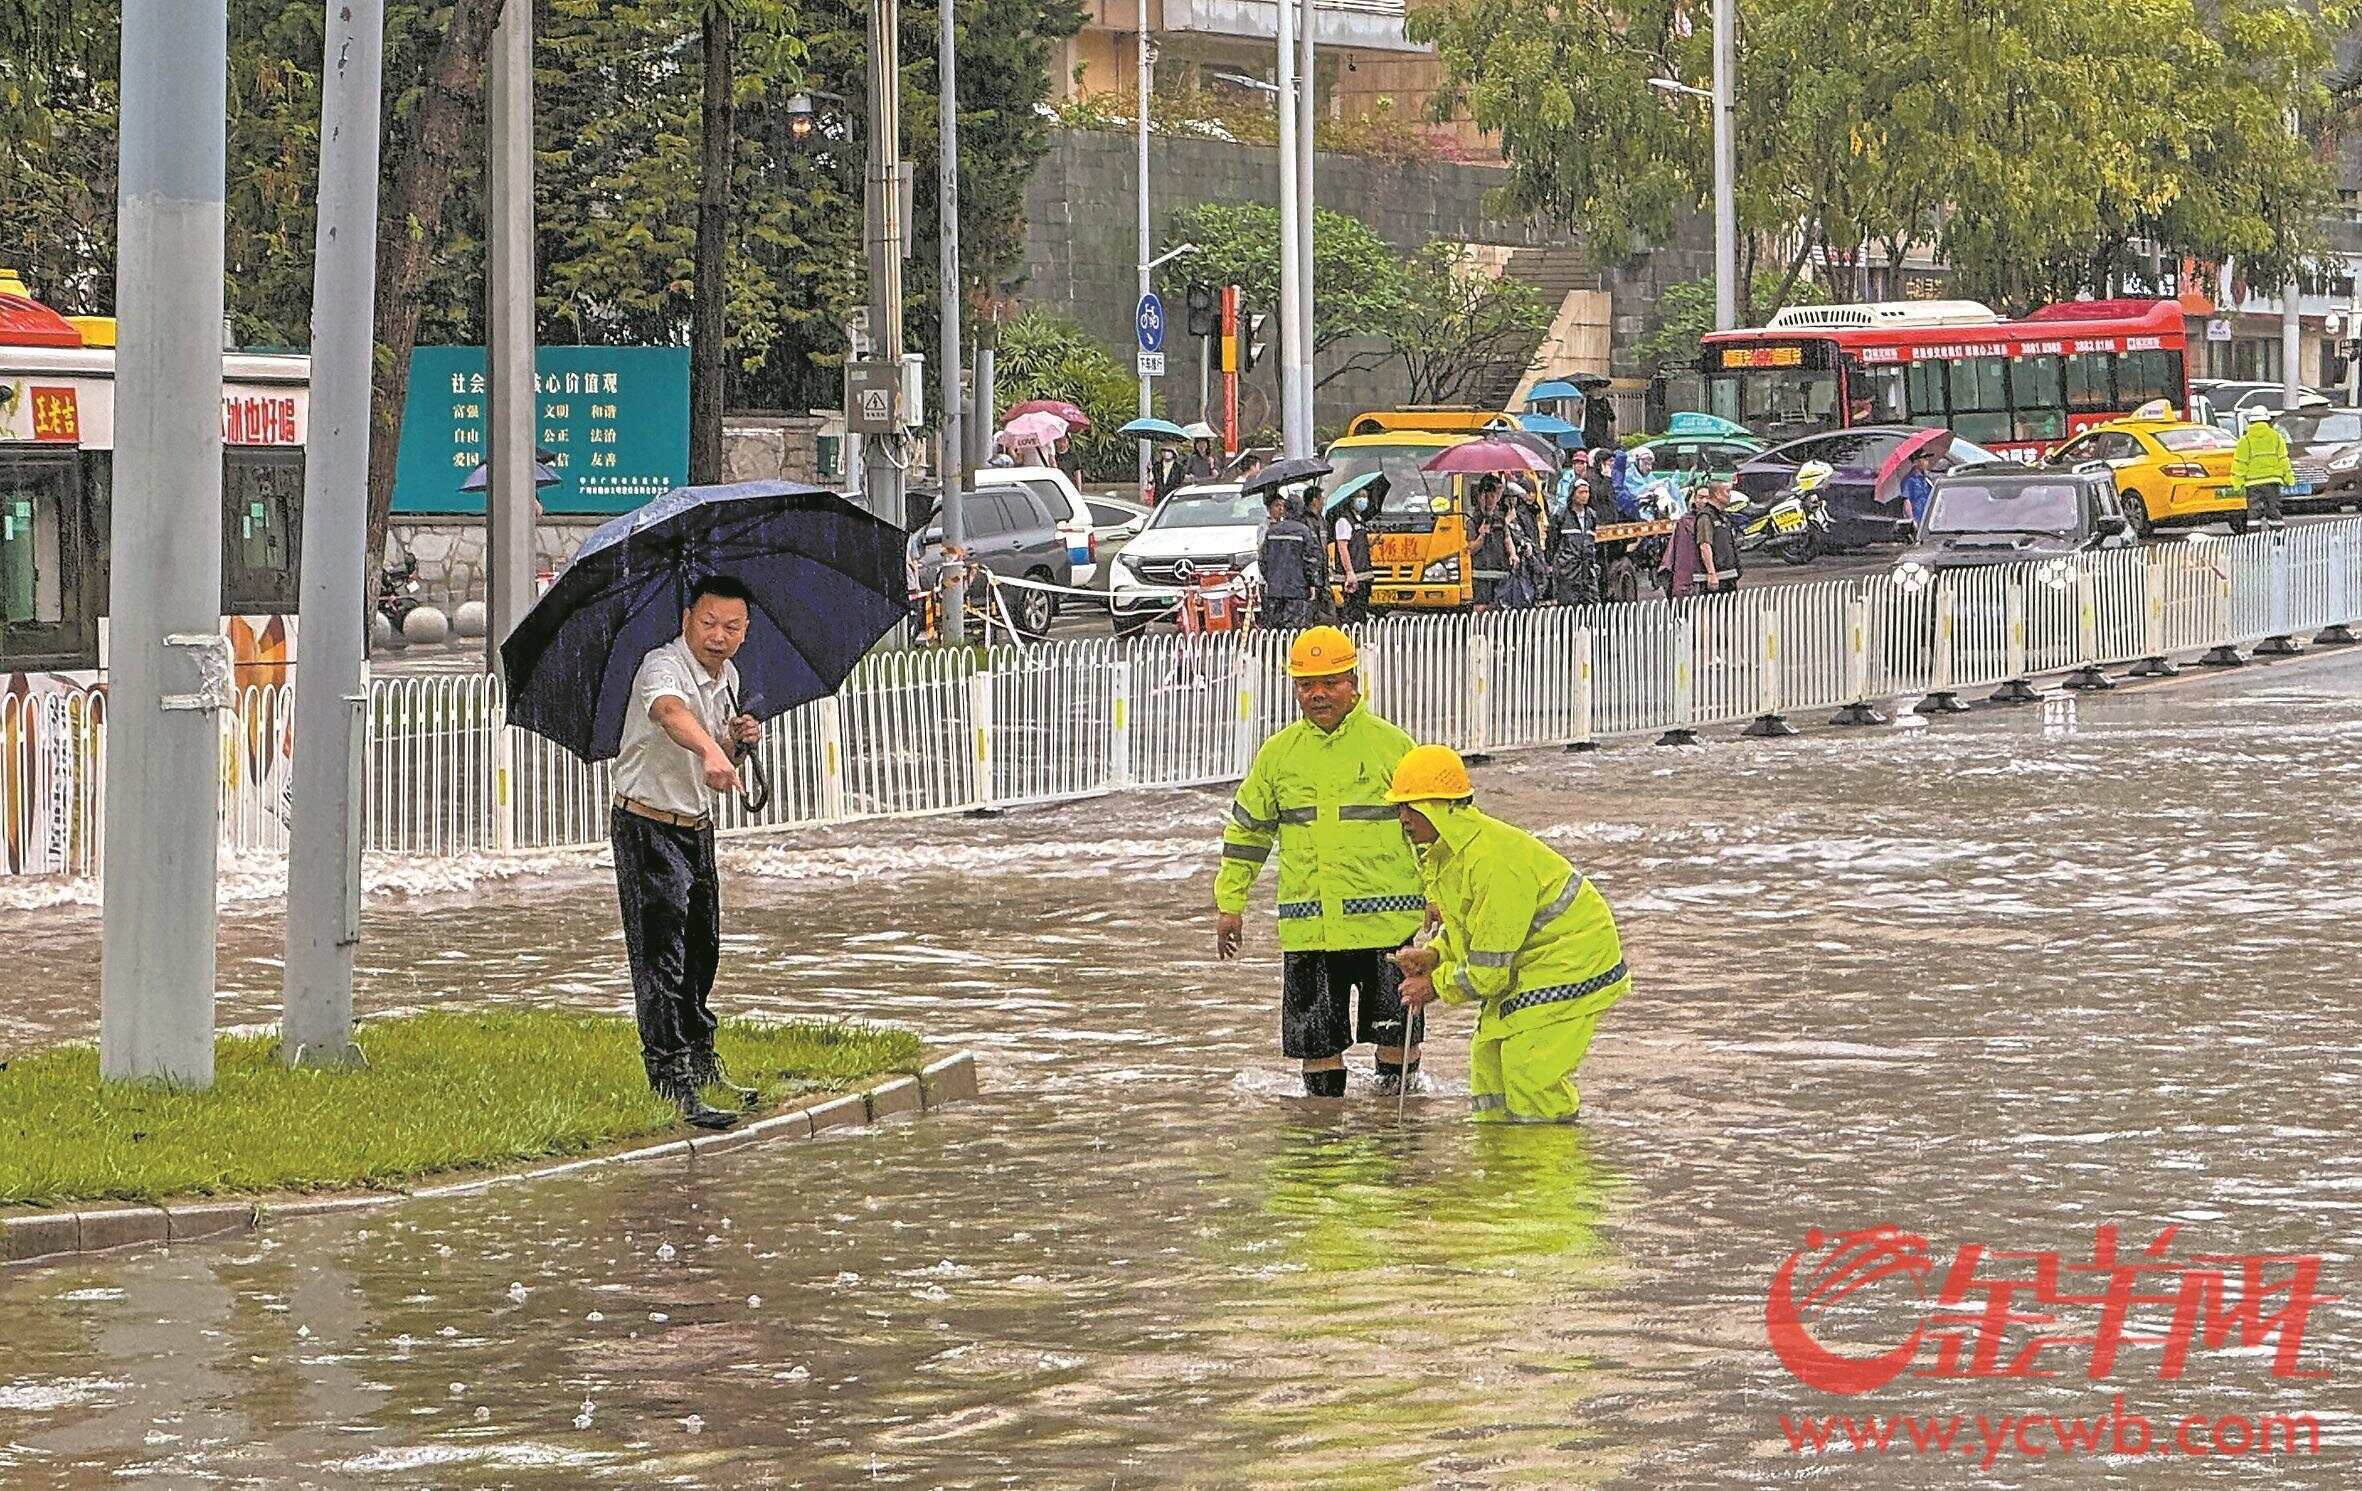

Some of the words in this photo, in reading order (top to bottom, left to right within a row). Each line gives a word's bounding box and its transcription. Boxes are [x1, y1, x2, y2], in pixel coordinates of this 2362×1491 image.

[36, 395, 75, 433] 王老吉
[453, 404, 479, 418] 富强
[544, 404, 569, 418] 文明
[591, 404, 617, 419] 和谐
[222, 397, 295, 443] 冰也好喝
[453, 428, 479, 443] 自由
[544, 428, 569, 443] 公正
[590, 428, 617, 443] 法治
[452, 452, 480, 467] 爱国
[591, 452, 617, 468] 友善
